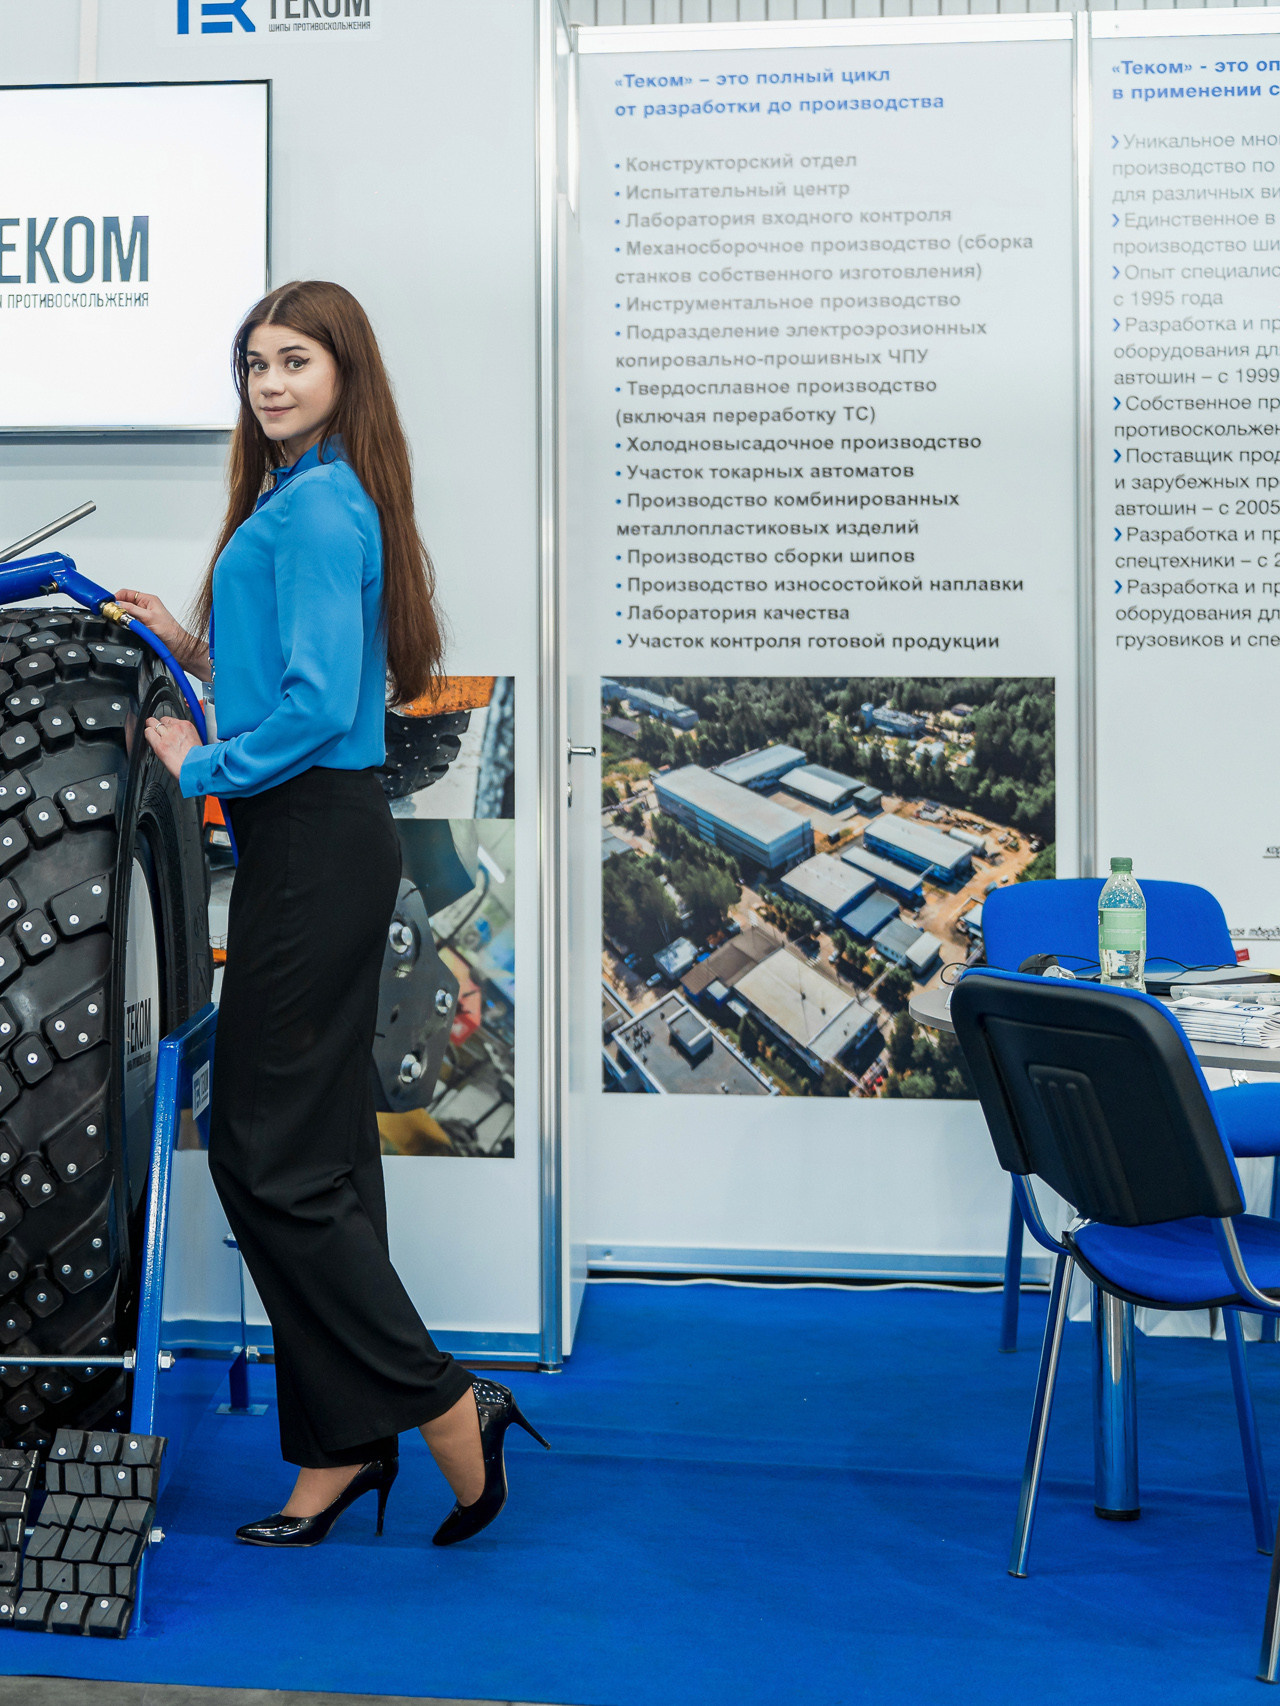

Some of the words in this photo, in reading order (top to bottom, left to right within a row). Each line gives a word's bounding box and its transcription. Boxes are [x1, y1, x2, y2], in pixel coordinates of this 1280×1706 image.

[268, 23, 290, 32] ШИПЫ
[292, 21, 371, 32] ПРОТИВОСКОЛЬЖЕНИЯ
[1113, 60, 1192, 75] «Теком»
[1215, 61, 1248, 73] это
[615, 73, 692, 88] «Теком»
[717, 74, 748, 86] это
[757, 68, 833, 84] полный
[842, 70, 889, 85] цикл
[1132, 85, 1261, 102] применении
[615, 105, 636, 116] от
[644, 99, 760, 119] разработки
[768, 101, 792, 115] до
[800, 97, 943, 114] производства
[1123, 134, 1235, 149] Уникальное
[626, 153, 793, 174] Конструкторский
[800, 156, 856, 170] отдел
[1113, 161, 1246, 178] производство
[626, 182, 786, 200] Испытательный
[793, 184, 850, 199] центр
[1153, 187, 1254, 205] различных
[626, 212, 755, 231] Лаборатория
[762, 211, 853, 226] входного
[860, 210, 951, 226] контроля
[1125, 212, 1259, 231] Единственное
[626, 238, 803, 258] Механосборочное
[811, 238, 951, 256] производство
[958, 233, 1033, 254] (сборка
[1113, 240, 1247, 257] производство
[615, 271, 691, 284] станков
[698, 267, 833, 282] собственного
[840, 263, 982, 282] изготовления)
[1125, 264, 1175, 280] Опыт
[7, 292, 149, 309] ПРОТИВОСКОЛЬЖЕНИЯ
[626, 296, 813, 315] Инструментальное
[821, 295, 960, 312] производство
[1131, 290, 1175, 306] 1995
[1181, 293, 1223, 309] года
[627, 324, 779, 343] Подразделение
[786, 323, 986, 340] электроэрозионных
[1126, 316, 1236, 336] Разработка
[616, 352, 881, 371] копировально-прошивных
[889, 349, 928, 364] ЧПУ
[1114, 343, 1249, 362] оборудования
[1114, 372, 1195, 385] автошин
[1236, 368, 1280, 384] 1999
[627, 380, 789, 399] Твердосплавное
[797, 381, 936, 397] производство
[1126, 395, 1251, 411] Собственное
[616, 408, 705, 427] (включая
[713, 406, 836, 427] переработку
[843, 406, 875, 425] ТС)
[627, 436, 833, 453] Холодновысадочное
[841, 437, 981, 453] производство
[1127, 447, 1233, 465] Поставщик
[627, 464, 703, 479] Участок
[710, 467, 803, 482] токарных
[810, 466, 914, 479] автоматов
[1132, 473, 1249, 493] зарубежных
[628, 493, 767, 511] Производство
[774, 491, 959, 509] комбинированных
[1115, 504, 1196, 516] автошин
[1236, 500, 1280, 515] 2005
[617, 523, 829, 536] металлопластиковых
[836, 520, 918, 537] изделий
[1127, 526, 1237, 545] Разработка
[628, 549, 767, 567] Производство
[774, 548, 842, 566] сборки
[850, 552, 914, 562] шипов
[1115, 555, 1234, 571] спецтехники
[628, 577, 767, 595] Производство
[775, 576, 922, 592] износостойкой
[930, 580, 1023, 592] наплавки
[1128, 579, 1238, 597] Разработка
[627, 605, 756, 623] Лаборатория
[764, 609, 849, 620] качества
[1116, 606, 1251, 624] оборудования
[628, 634, 703, 648] Участок
[711, 637, 800, 651] контроля
[808, 634, 884, 648] готовой
[893, 637, 999, 652] продукции
[1117, 635, 1223, 651] грузовиков
